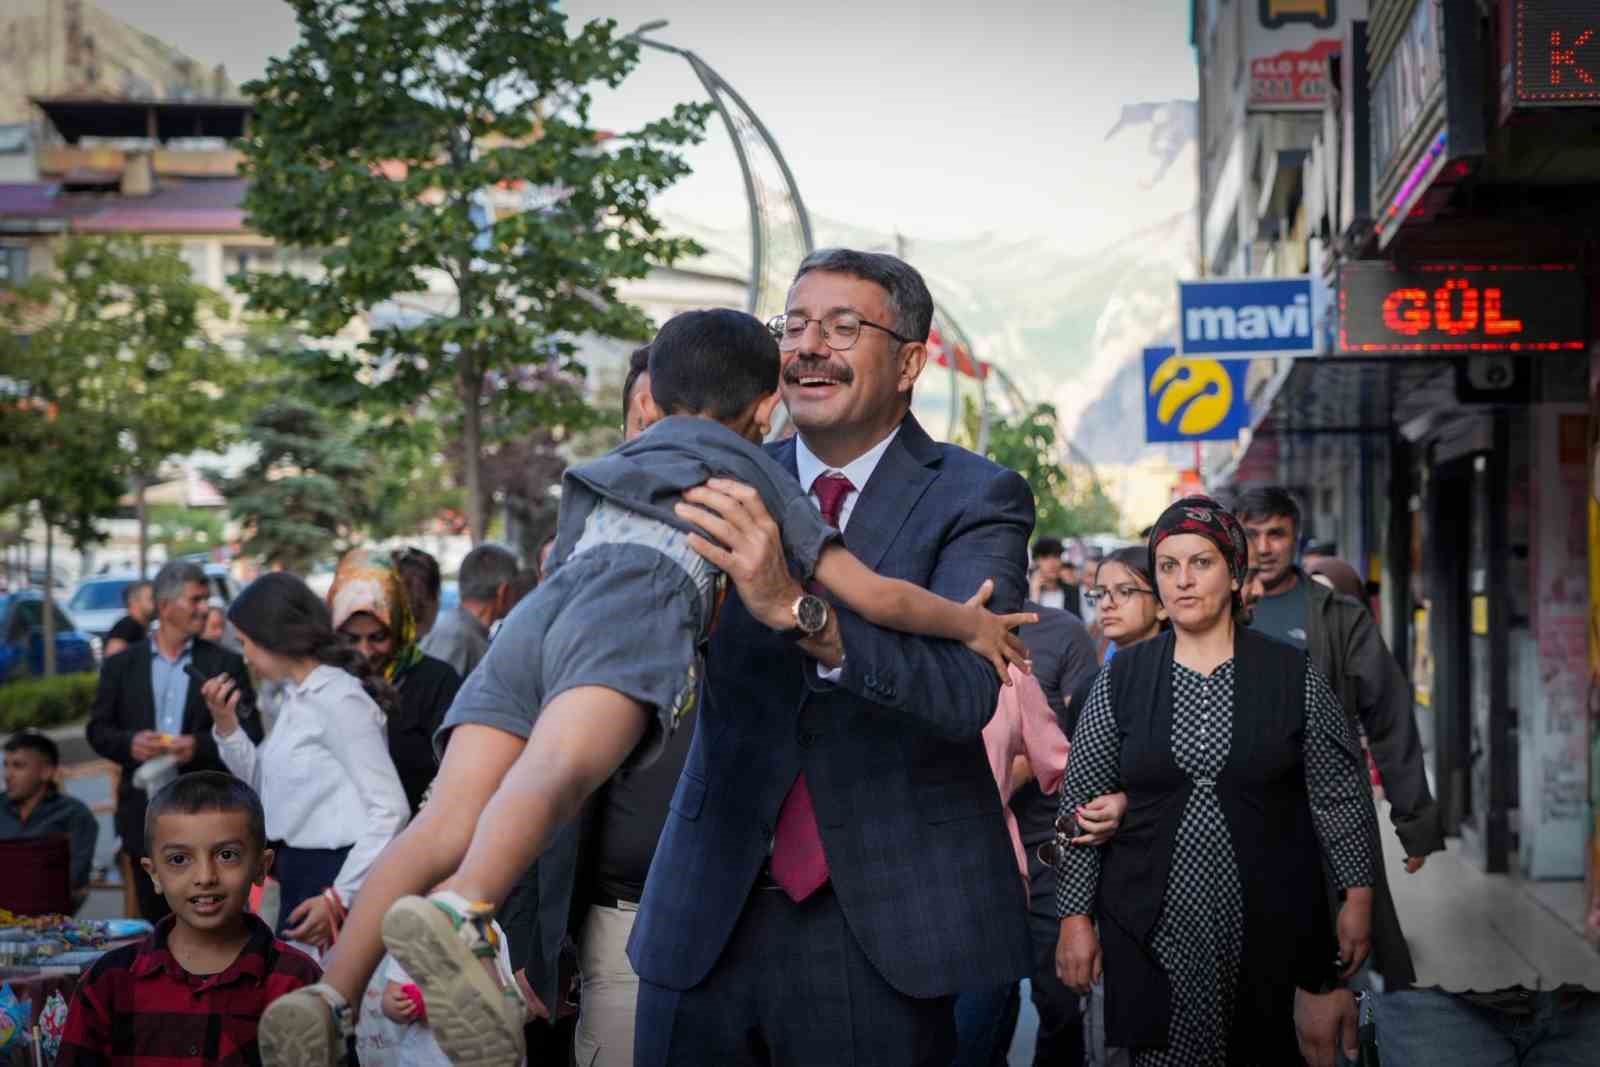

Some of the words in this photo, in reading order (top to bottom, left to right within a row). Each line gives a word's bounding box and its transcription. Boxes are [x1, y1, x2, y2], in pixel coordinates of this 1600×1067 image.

[1551, 30, 1593, 85] K
[1186, 294, 1308, 341] mavi
[1382, 279, 1522, 335] GÜL
